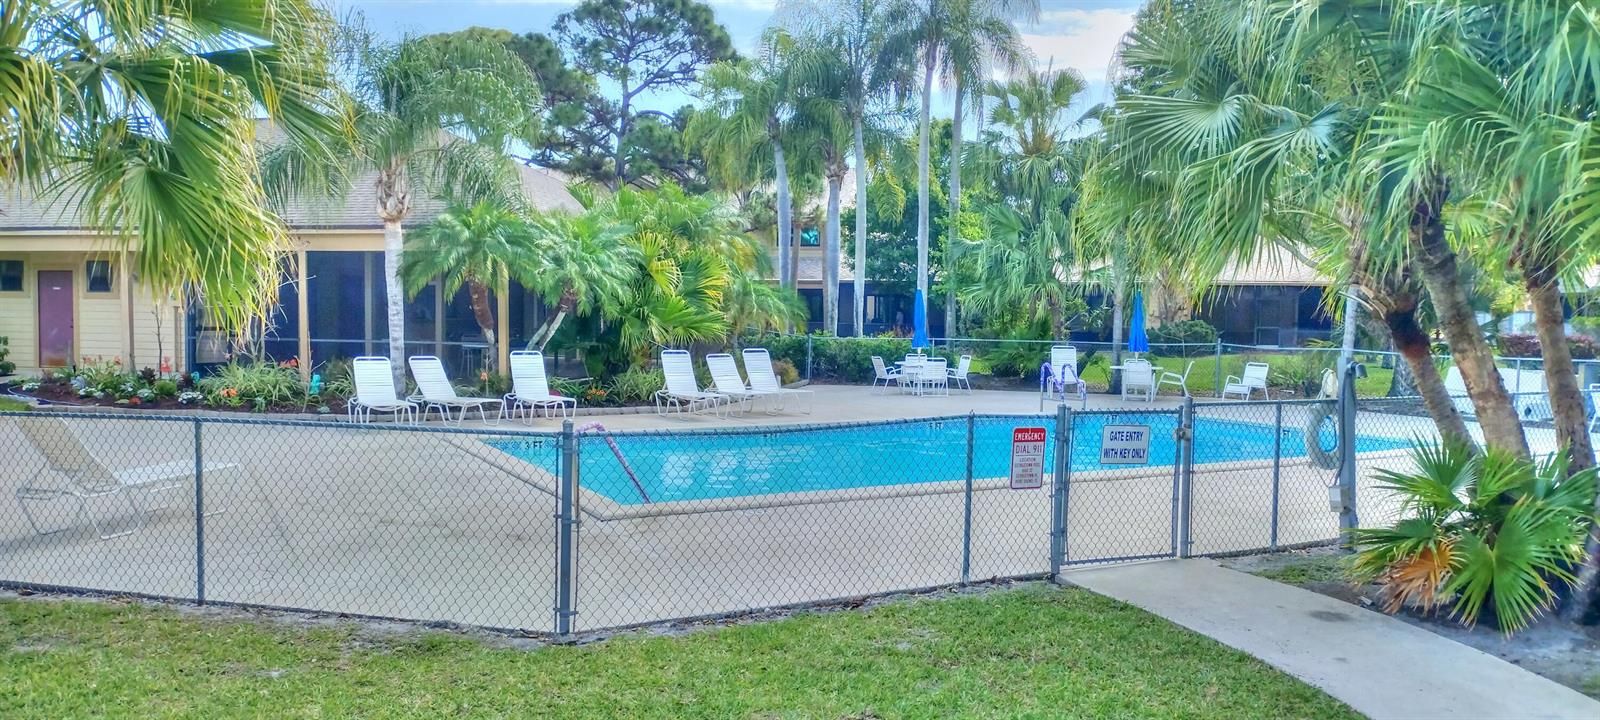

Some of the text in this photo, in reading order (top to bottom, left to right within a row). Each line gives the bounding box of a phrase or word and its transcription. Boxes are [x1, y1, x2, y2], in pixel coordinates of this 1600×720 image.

[1014, 432, 1045, 441] EMERGENCY
[1110, 431, 1144, 441] GATE ENTRY
[525, 440, 543, 450] 3 FT
[1015, 444, 1042, 454] DIAL 911
[1103, 448, 1146, 458] WITH KEY ONLY
